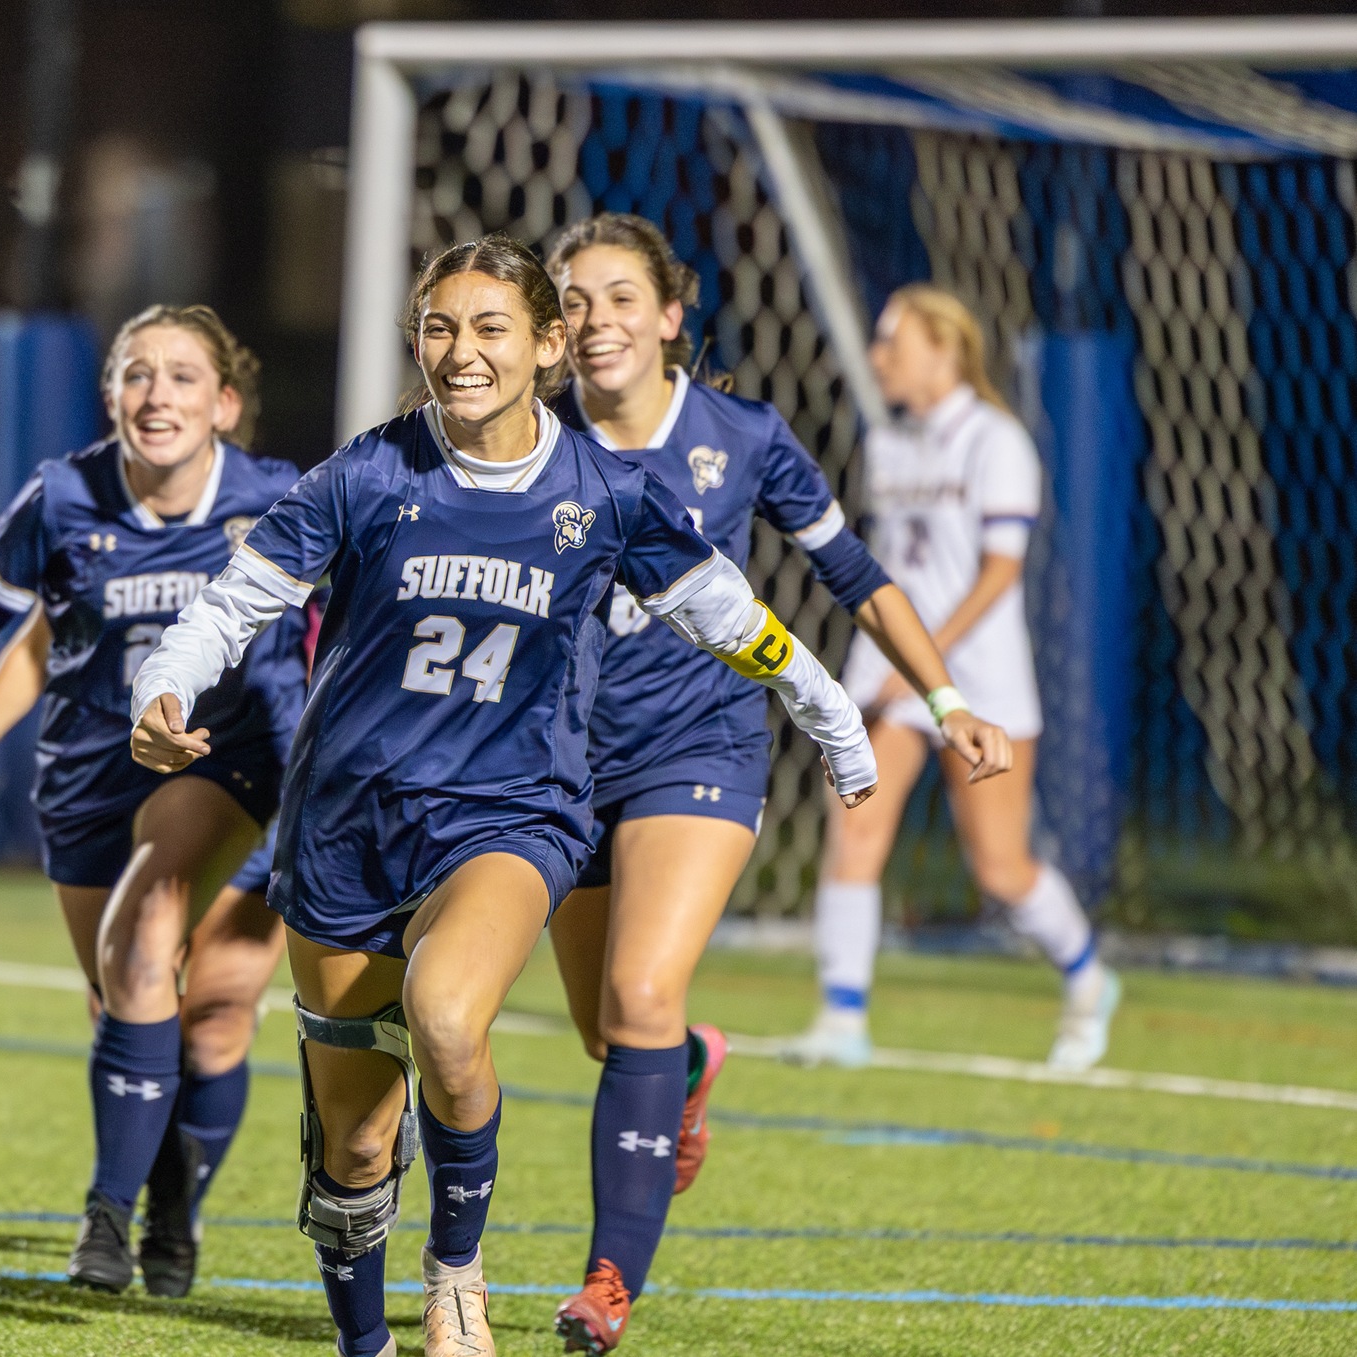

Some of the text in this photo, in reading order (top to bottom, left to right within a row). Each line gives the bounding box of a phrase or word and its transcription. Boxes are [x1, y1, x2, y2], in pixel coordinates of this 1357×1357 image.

[103, 571, 219, 619] SUFFO
[397, 554, 554, 619] SUFFOLK
[401, 614, 520, 703] 24
[752, 634, 788, 671] C
